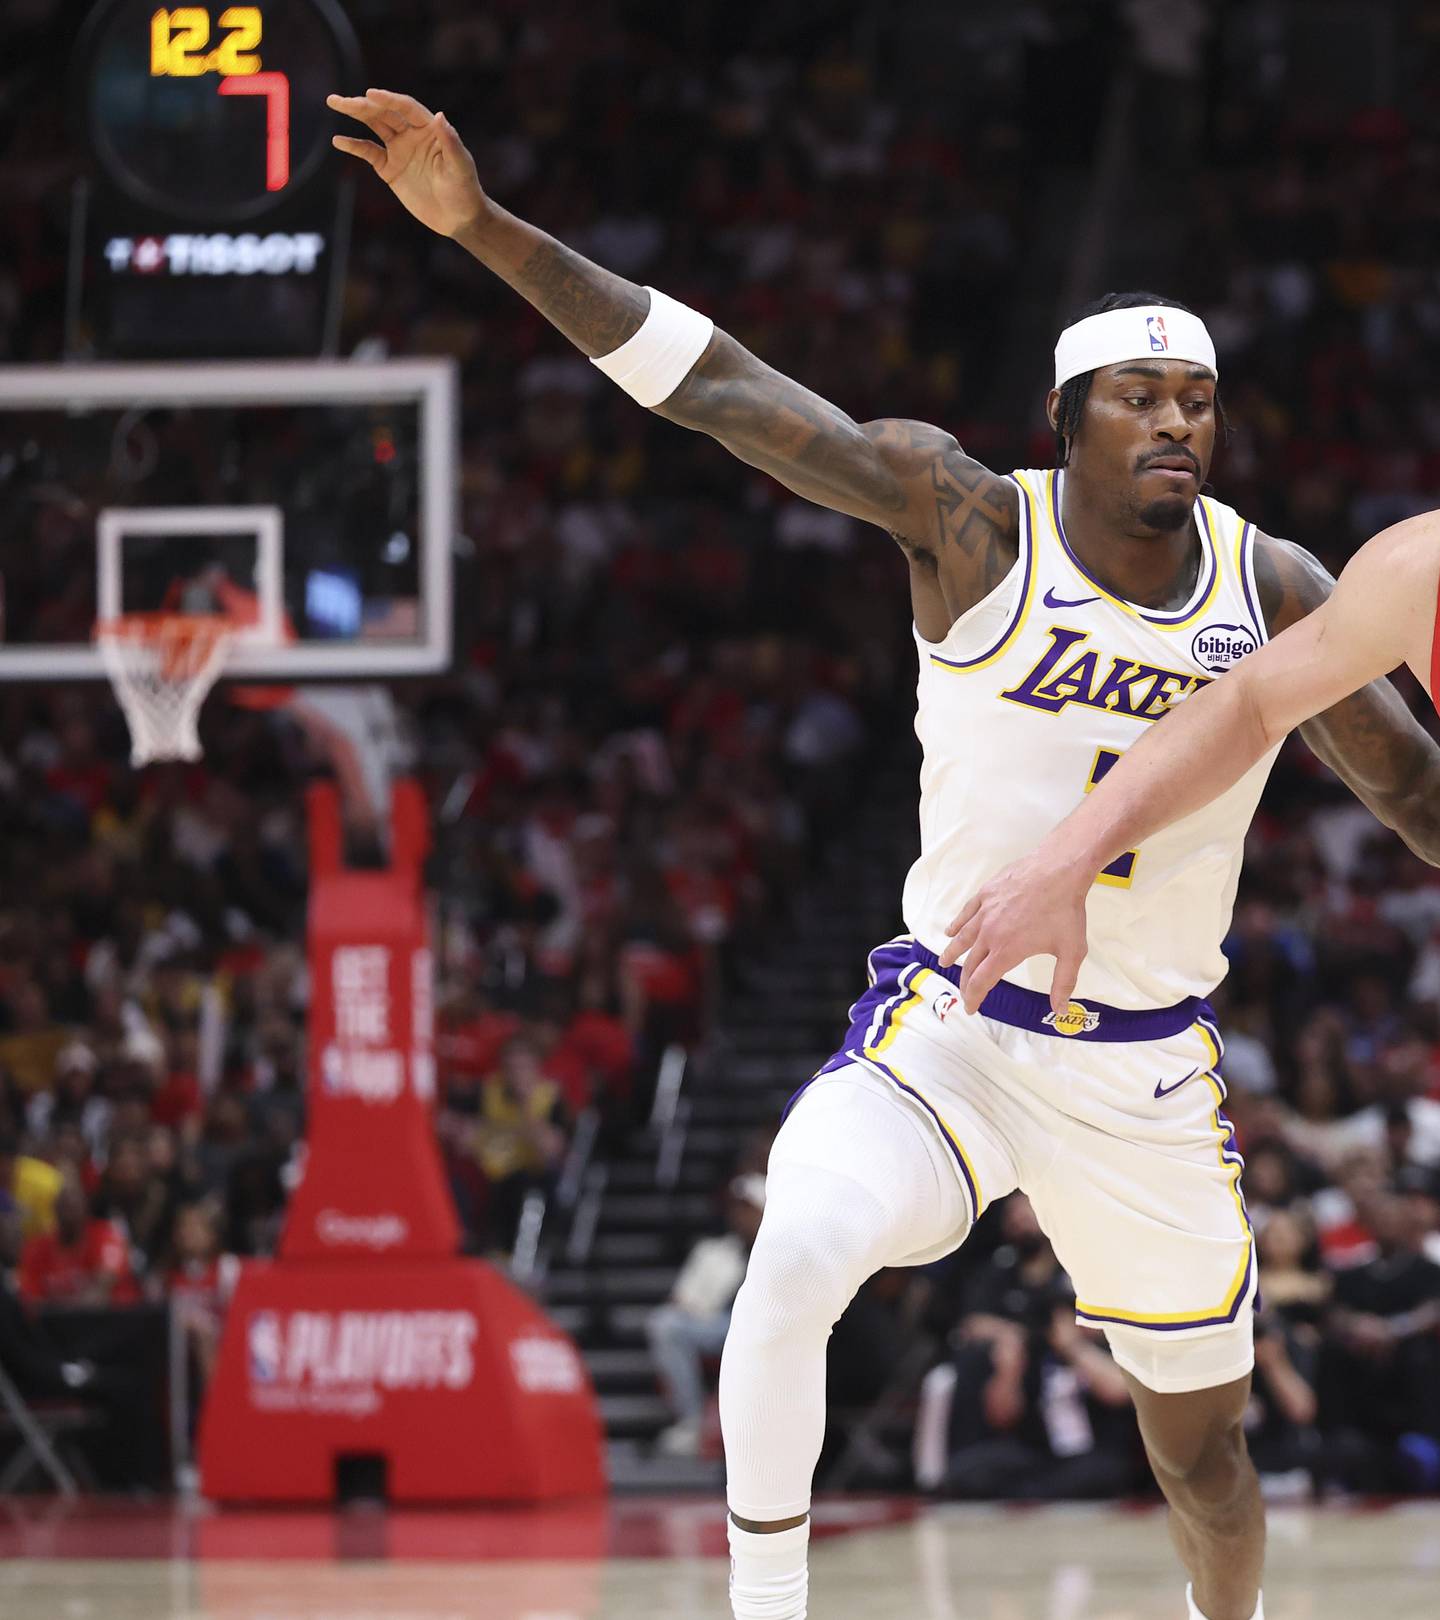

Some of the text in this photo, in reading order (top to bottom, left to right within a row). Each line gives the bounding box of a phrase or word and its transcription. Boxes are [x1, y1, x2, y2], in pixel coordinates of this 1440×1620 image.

[218, 71, 289, 192] 7
[165, 233, 323, 274] TISSOT
[999, 624, 1214, 723] LAKE
[1198, 637, 1253, 659] bibigo
[1207, 654, 1230, 662] 비비고
[285, 1311, 479, 1389] PLAYOFFS
